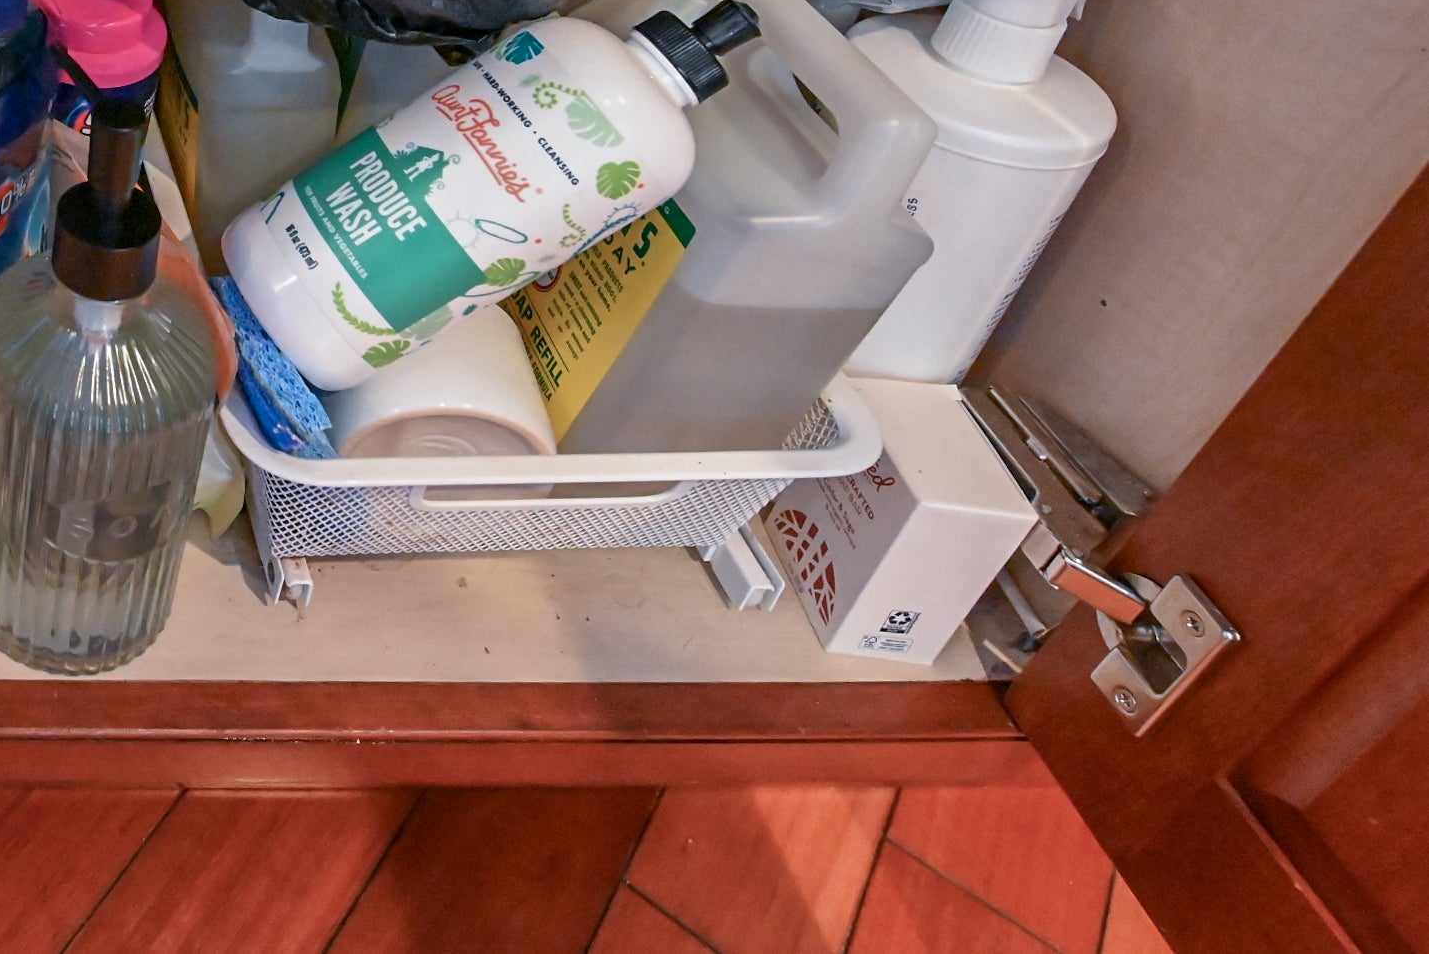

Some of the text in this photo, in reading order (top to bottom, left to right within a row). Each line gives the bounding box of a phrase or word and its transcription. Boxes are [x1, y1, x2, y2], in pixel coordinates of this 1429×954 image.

[456, 99, 530, 202] Fannie's
[538, 137, 579, 185] CLEANSING
[326, 181, 382, 245] WASH
[349, 151, 427, 241] PRODUCE
[322, 217, 335, 234] AND
[334, 234, 368, 279] VEGETABLES
[511, 293, 533, 321] OAP
[530, 326, 564, 388] REFILL
[846, 475, 874, 520] CRAFTED
